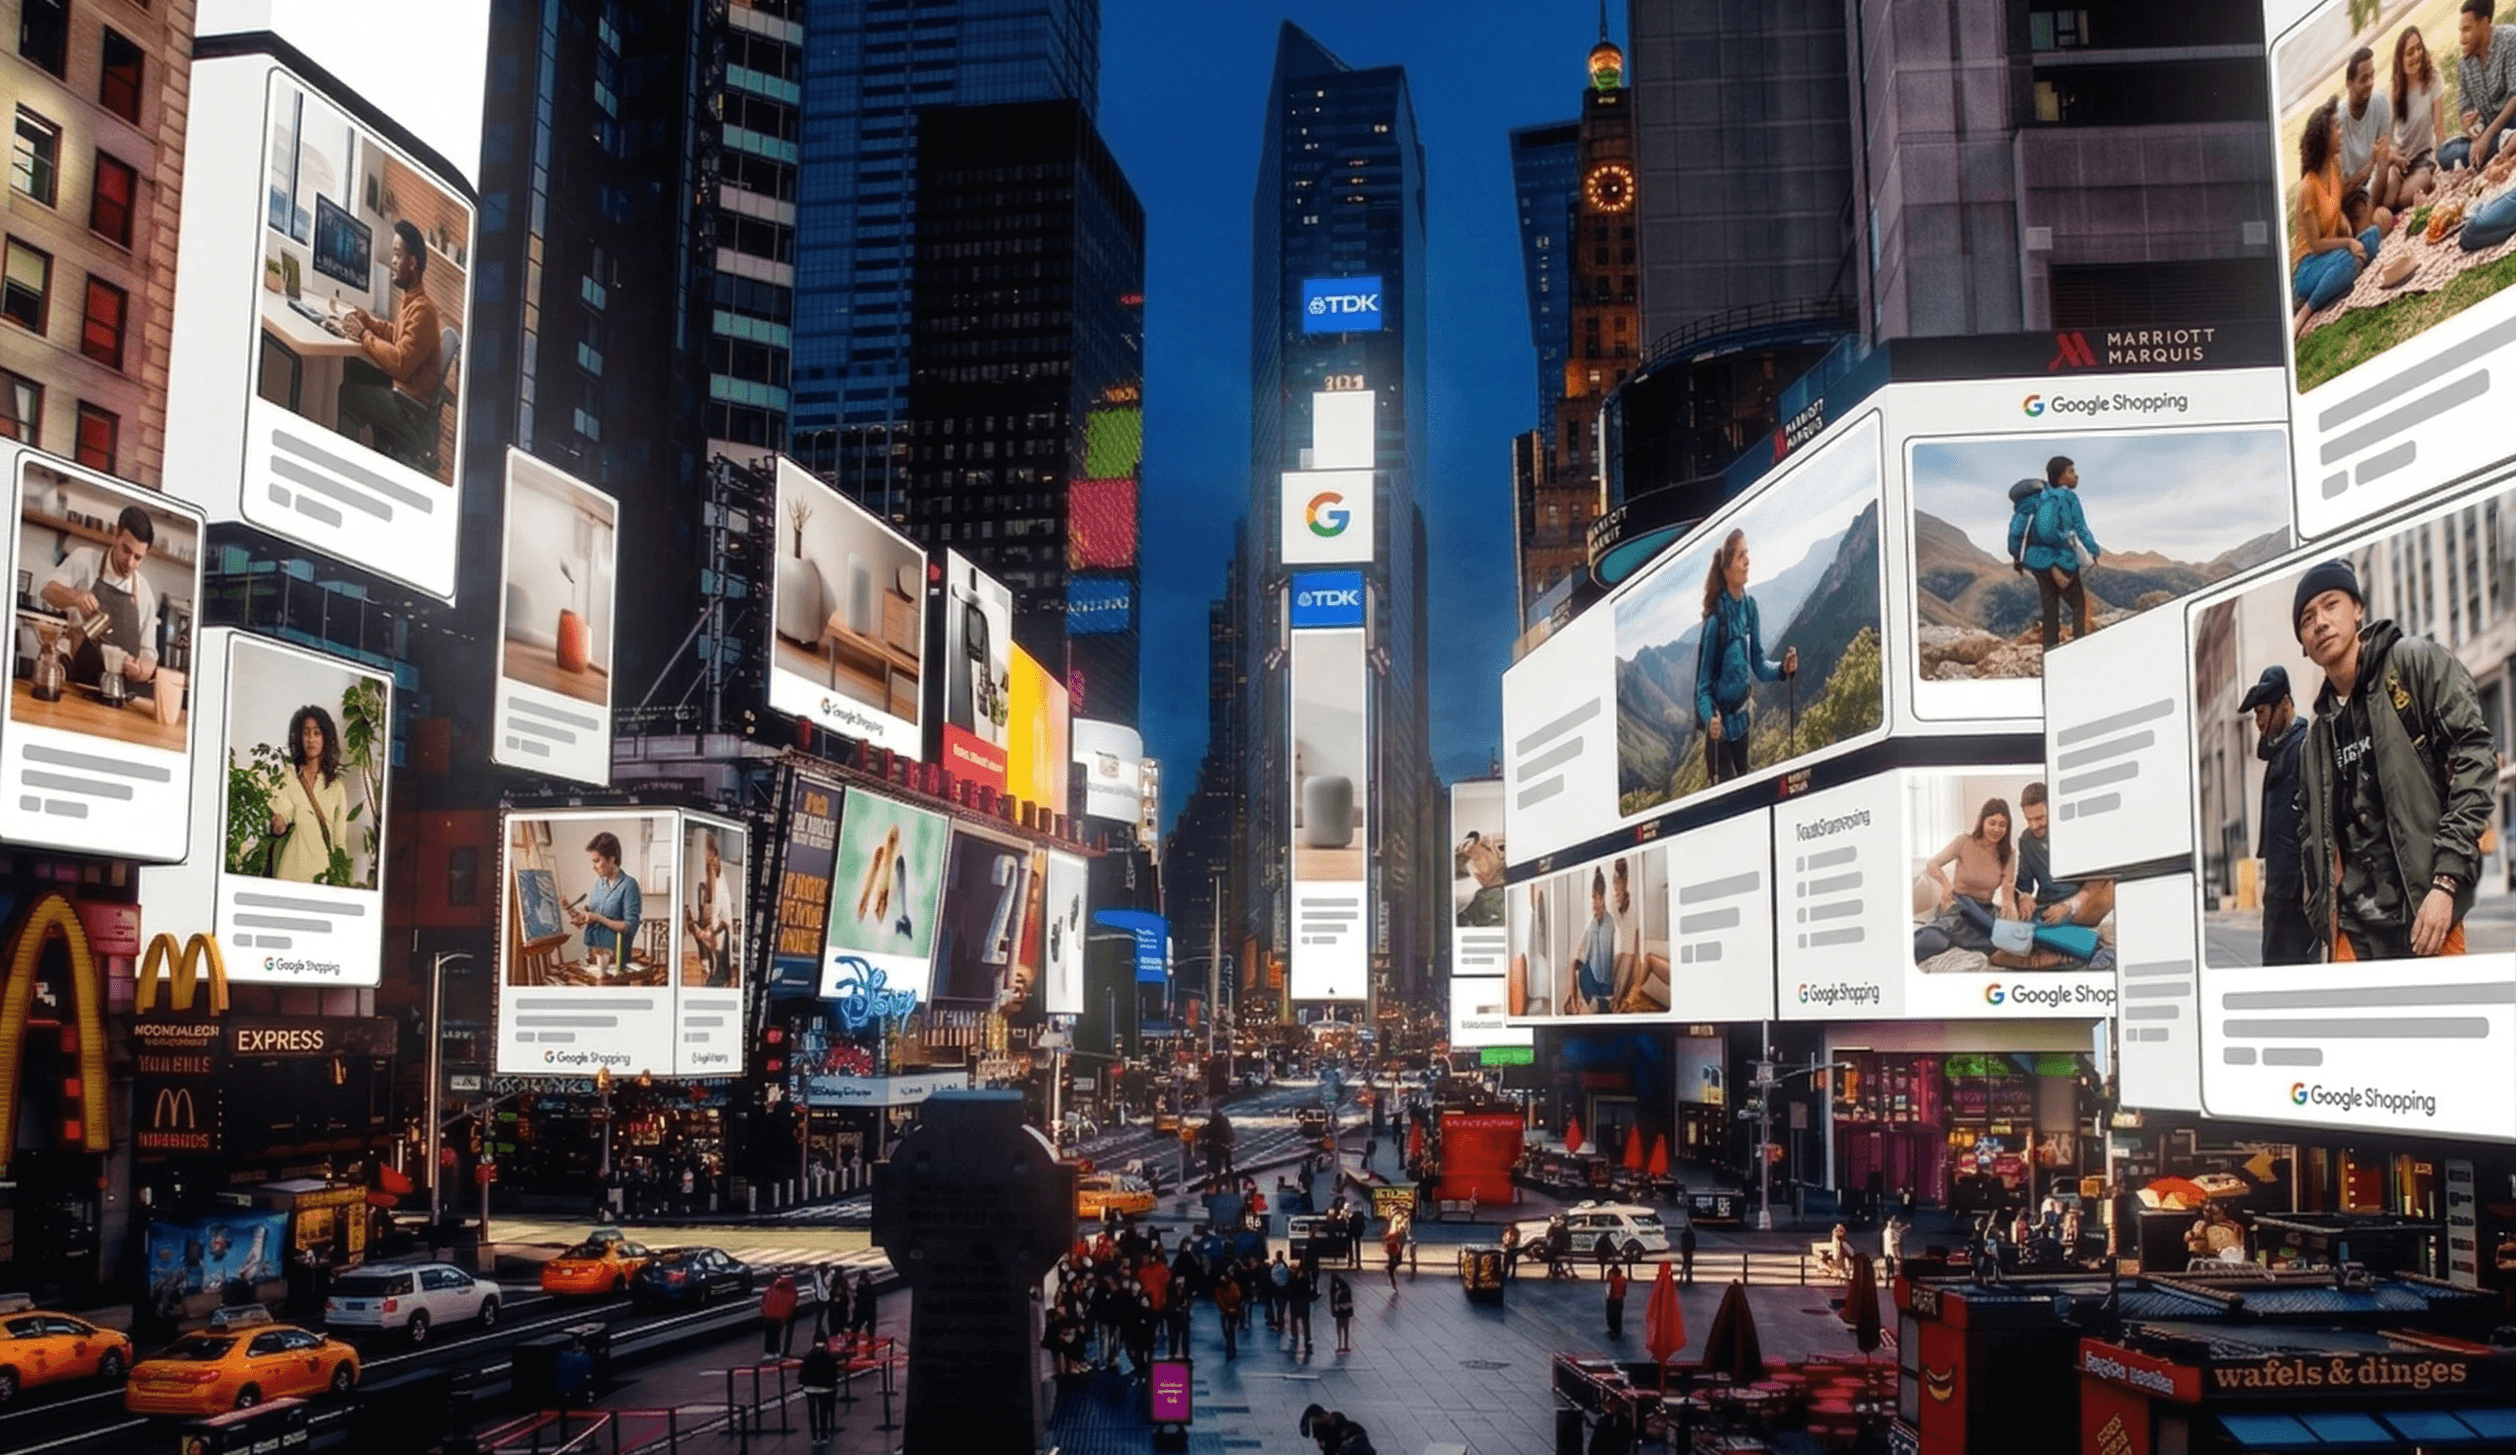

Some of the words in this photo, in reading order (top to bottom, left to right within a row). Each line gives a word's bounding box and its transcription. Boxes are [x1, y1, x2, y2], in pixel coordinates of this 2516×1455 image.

[1325, 294, 1379, 313] TDK
[2107, 328, 2215, 346] MARRIOTT
[2109, 347, 2204, 364] MARQUIS
[2051, 396, 2110, 416] Google
[2112, 393, 2188, 413] Shopping
[1311, 589, 1360, 606] TDK
[1810, 983, 1839, 1006] Google
[1840, 981, 1880, 1005] Shopping
[2012, 984, 2072, 1008] Google
[2075, 984, 2117, 1007] Shop
[238, 1030, 324, 1050] EXPRESS
[2311, 1084, 2363, 1111] Google
[2364, 1087, 2436, 1117] Shopping
[2214, 1359, 2323, 1387] wafels
[2328, 1358, 2354, 1385] &
[2358, 1357, 2467, 1389] dinges
